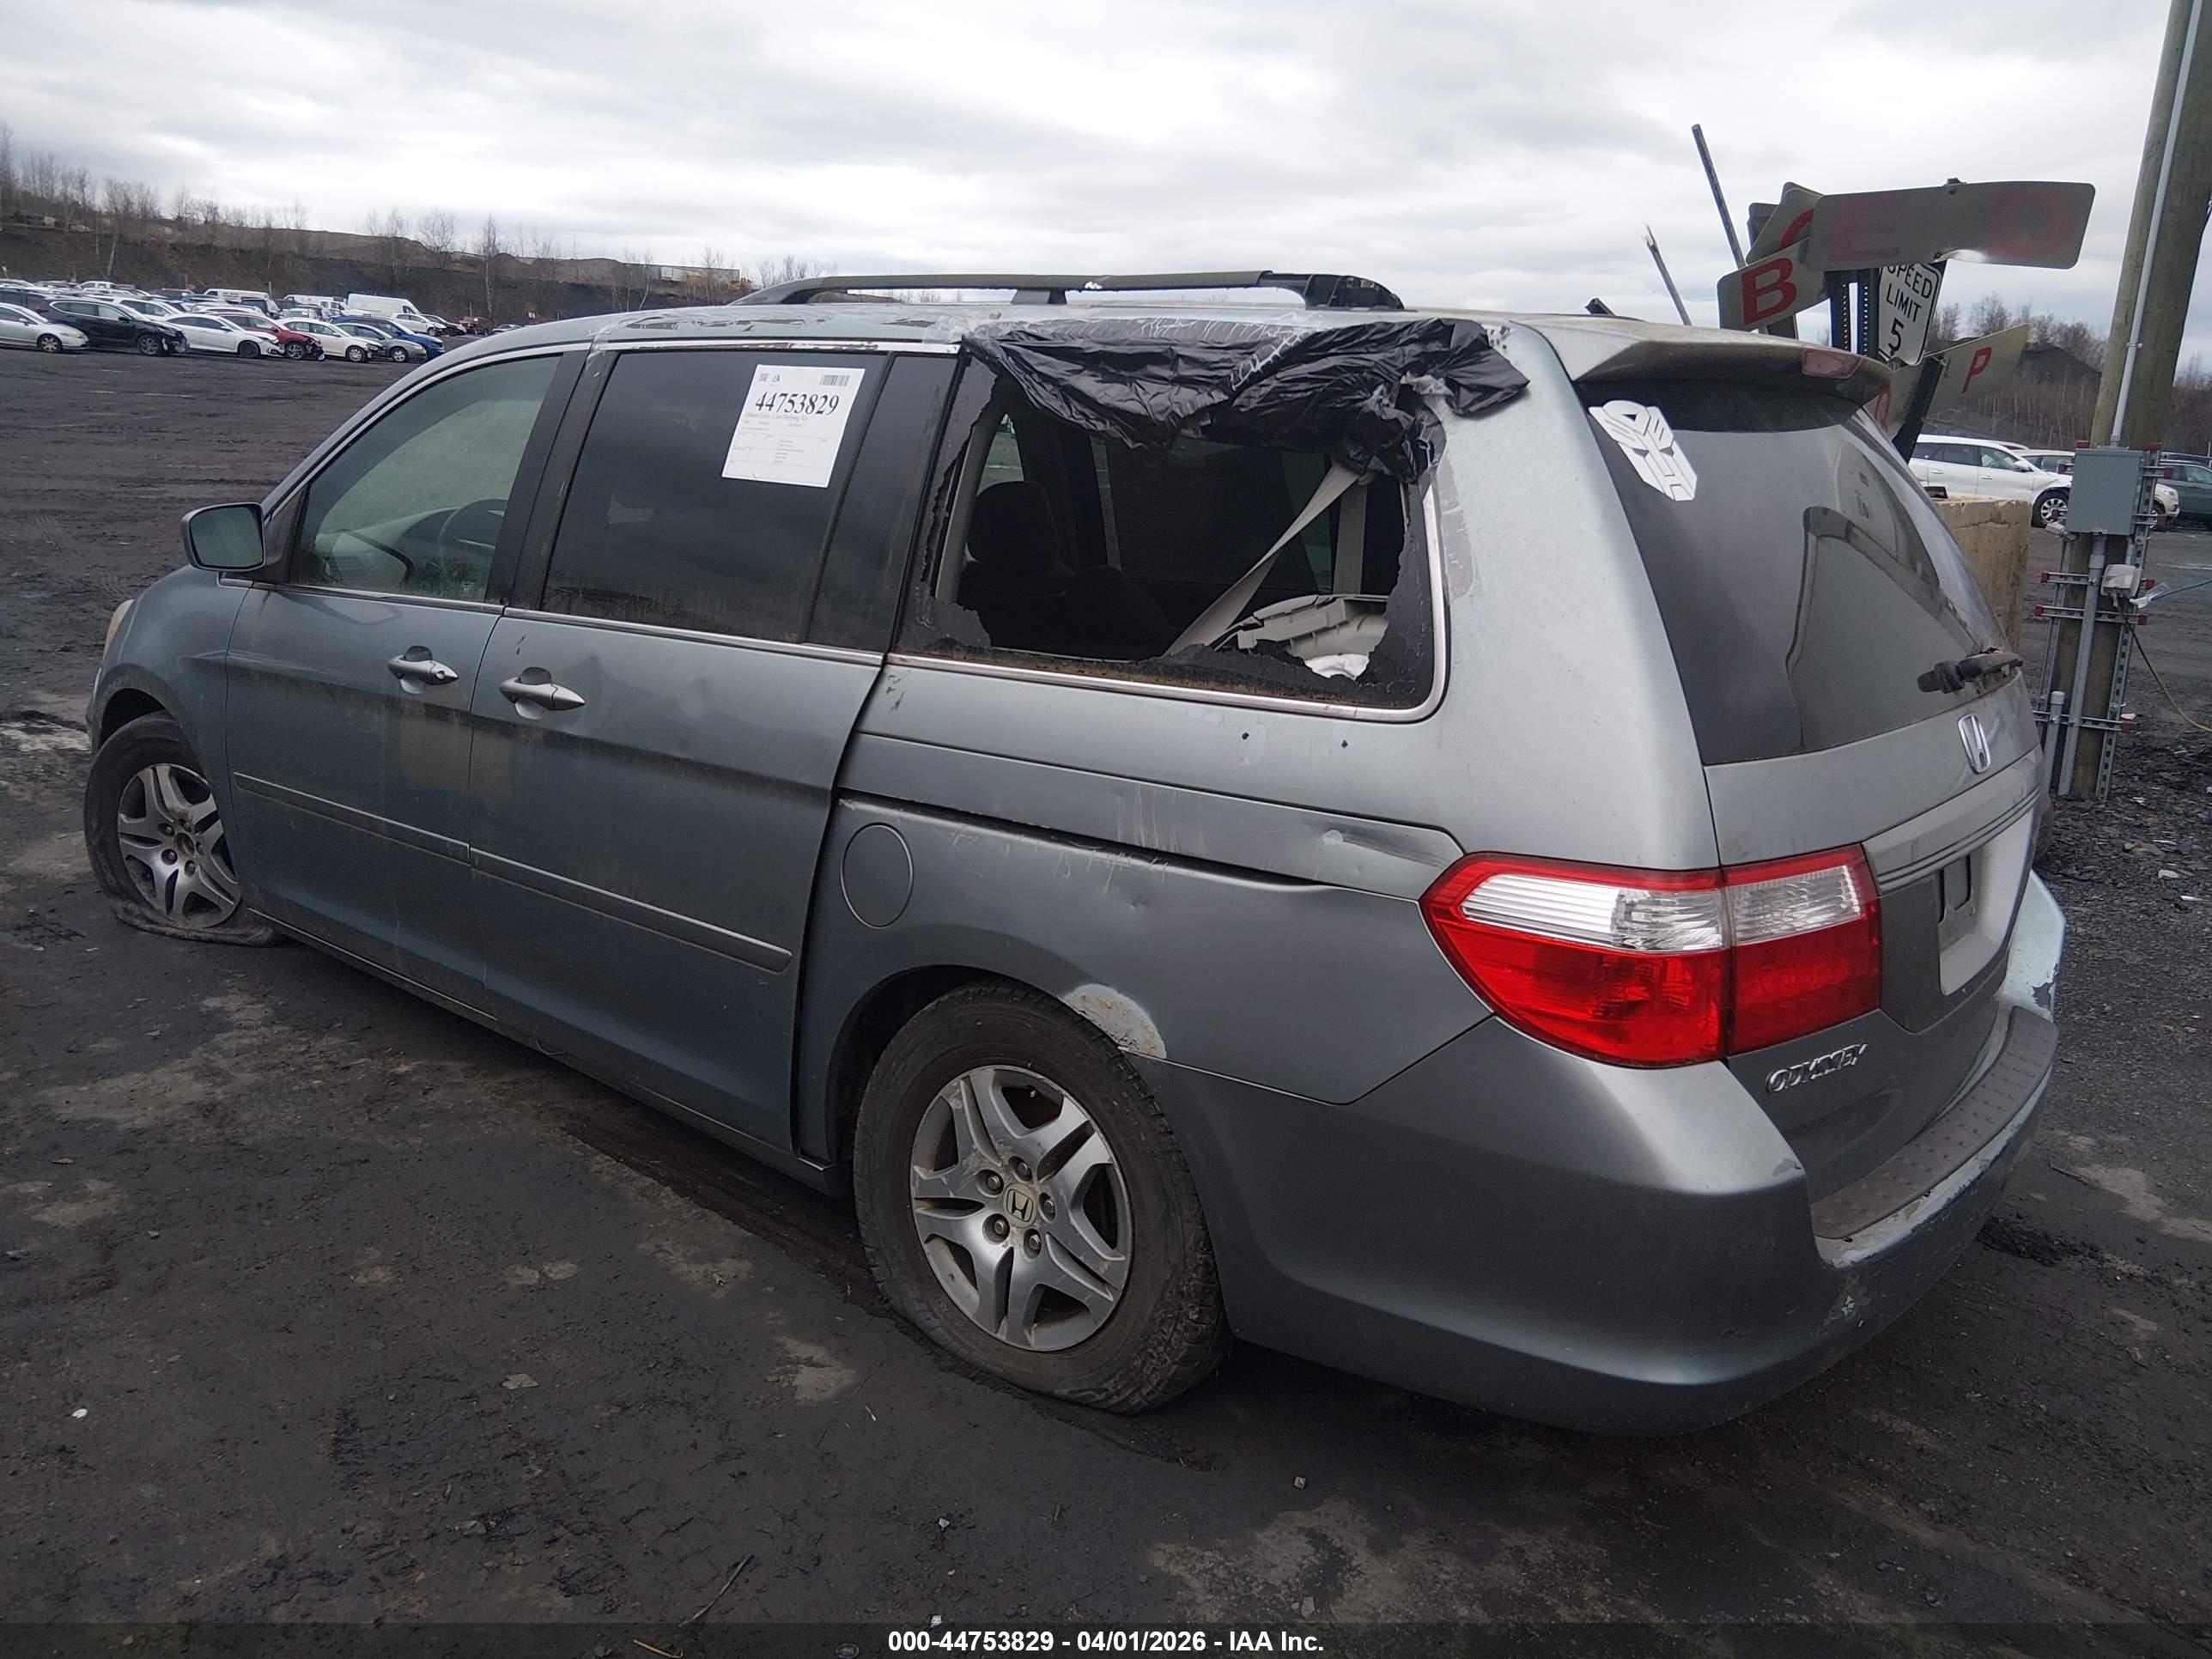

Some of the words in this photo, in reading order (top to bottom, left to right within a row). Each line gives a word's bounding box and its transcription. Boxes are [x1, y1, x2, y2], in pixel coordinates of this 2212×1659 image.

[1741, 257, 1796, 325] B
[1887, 283, 1922, 322] LIMIT
[1888, 318, 1904, 351] 5
[1960, 346, 1992, 394] P
[756, 391, 839, 416] 44753829
